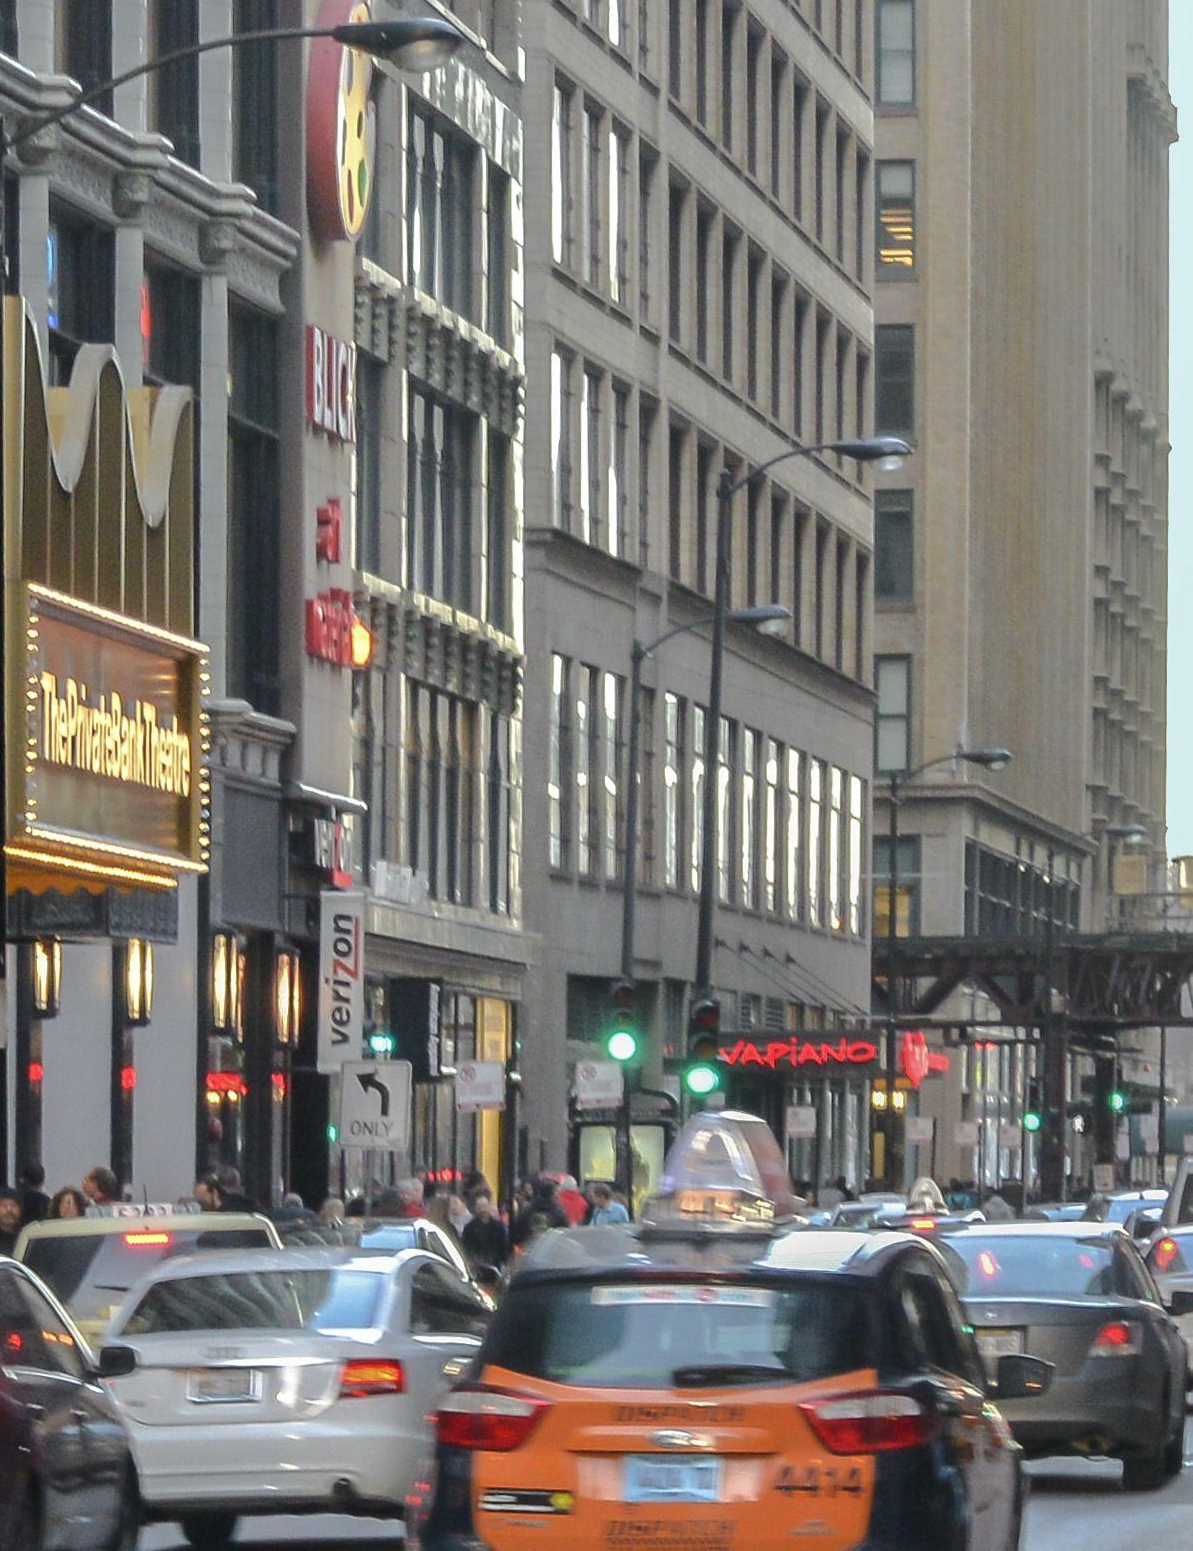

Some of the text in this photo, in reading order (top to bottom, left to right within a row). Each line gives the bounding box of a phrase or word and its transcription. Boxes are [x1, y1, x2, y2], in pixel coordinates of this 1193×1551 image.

[330, 913, 360, 1046] verizon
[717, 1036, 877, 1069] VAPIANO
[350, 1120, 395, 1138] ONLY
